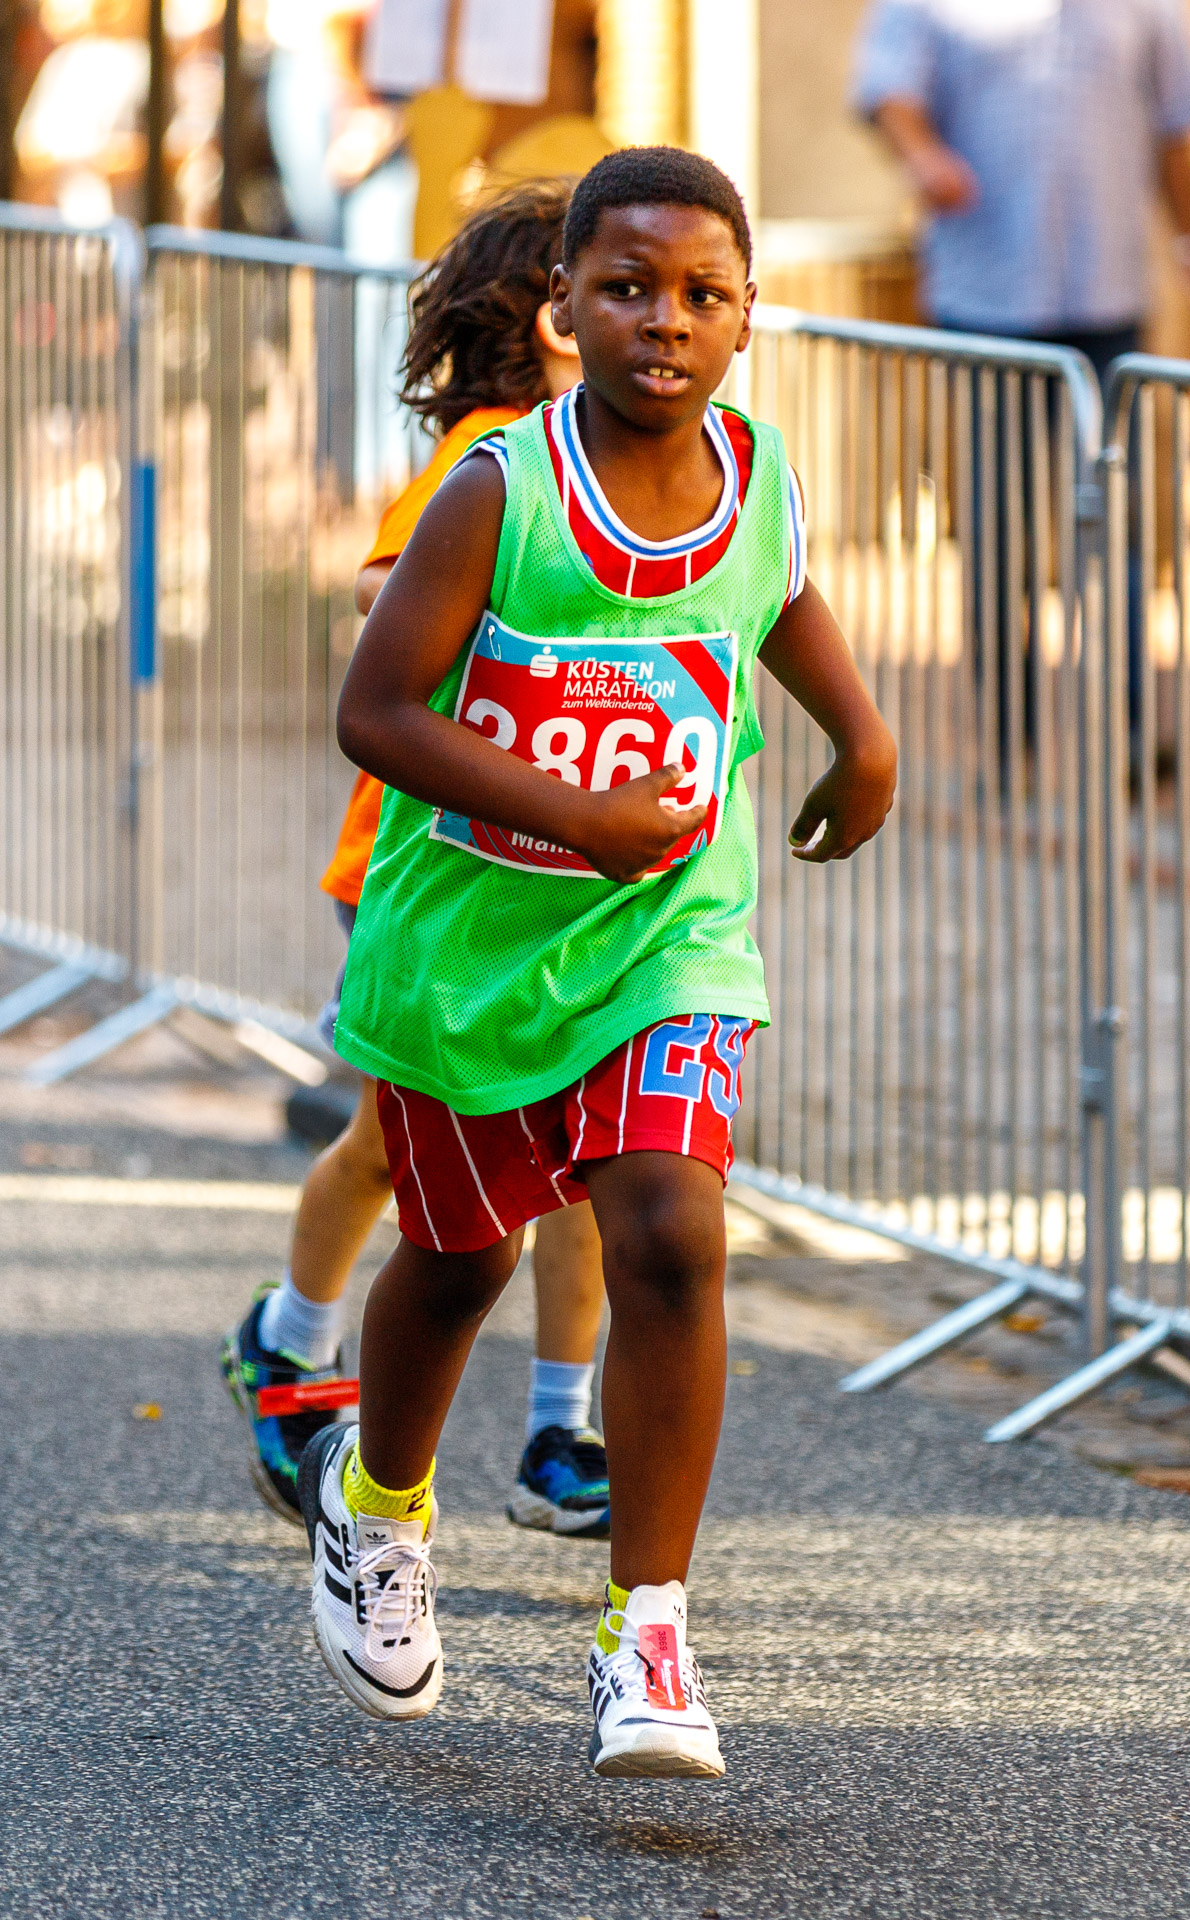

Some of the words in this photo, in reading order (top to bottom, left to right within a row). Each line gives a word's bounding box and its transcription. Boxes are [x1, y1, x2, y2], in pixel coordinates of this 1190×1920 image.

[567, 657, 654, 680] KÜSTEN
[563, 679, 676, 699] MARATHON
[561, 699, 584, 709] zum
[585, 698, 655, 713] Weltkindertag
